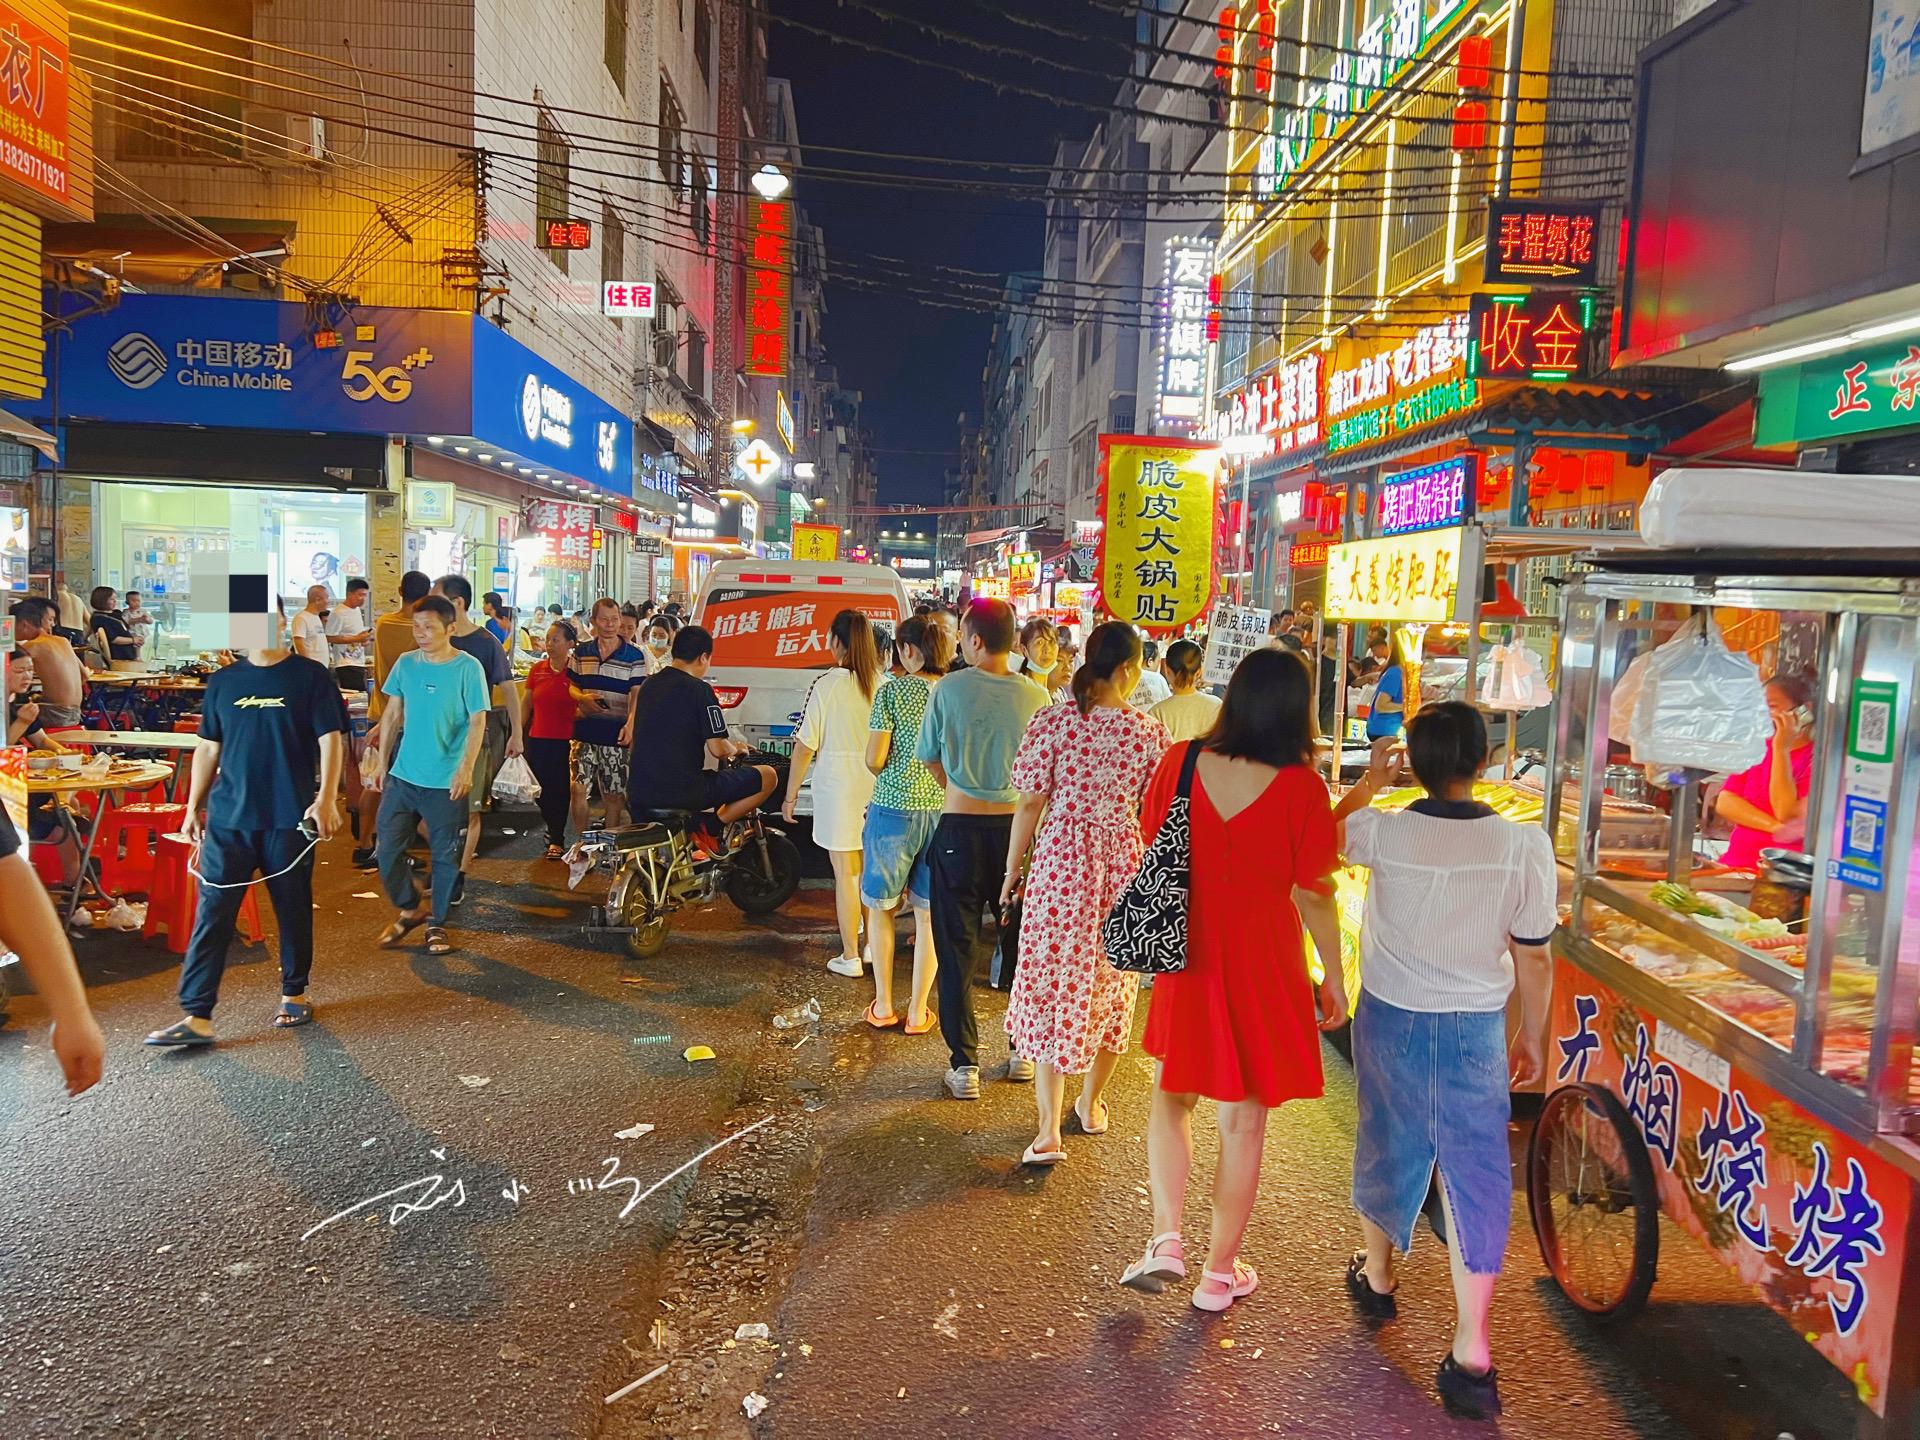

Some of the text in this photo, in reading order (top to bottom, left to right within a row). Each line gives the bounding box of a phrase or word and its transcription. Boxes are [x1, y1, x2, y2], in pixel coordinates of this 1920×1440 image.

[549, 223, 588, 246] 住宿
[1499, 214, 1593, 263] 手摇绣花
[607, 285, 652, 307] 住宿
[1481, 303, 1582, 370] 收金
[176, 338, 292, 371] 中国移动
[176, 369, 292, 392] China Mobile
[530, 503, 593, 533] 烧烤
[1131, 460, 1184, 623] 脆皮大锅贴
[712, 603, 817, 639] 拉货 搬家
[1214, 610, 1267, 634] 脆皮锅贴
[1216, 657, 1238, 671] 玉米
